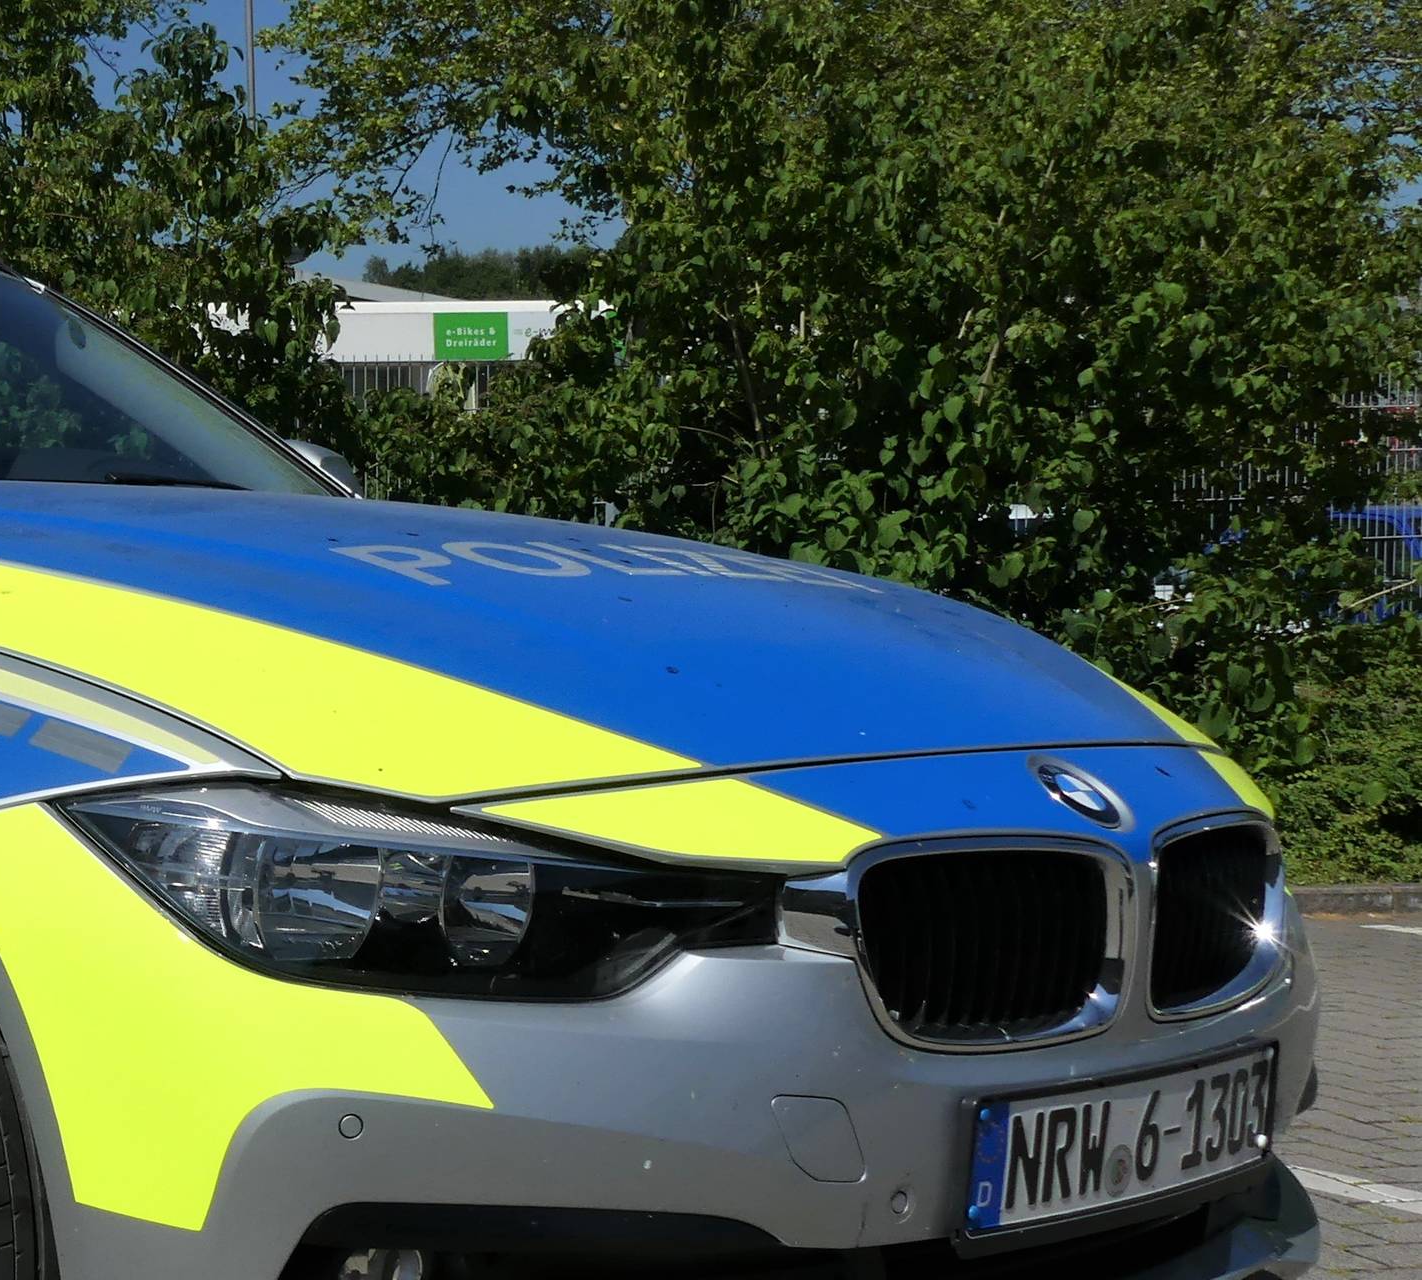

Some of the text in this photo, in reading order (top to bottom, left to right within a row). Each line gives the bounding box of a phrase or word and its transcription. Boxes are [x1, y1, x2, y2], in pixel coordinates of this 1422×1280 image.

[328, 541, 885, 594] POLIZEI
[1005, 1060, 1269, 1210] NRW 6-1303
[977, 1181, 993, 1207] D
